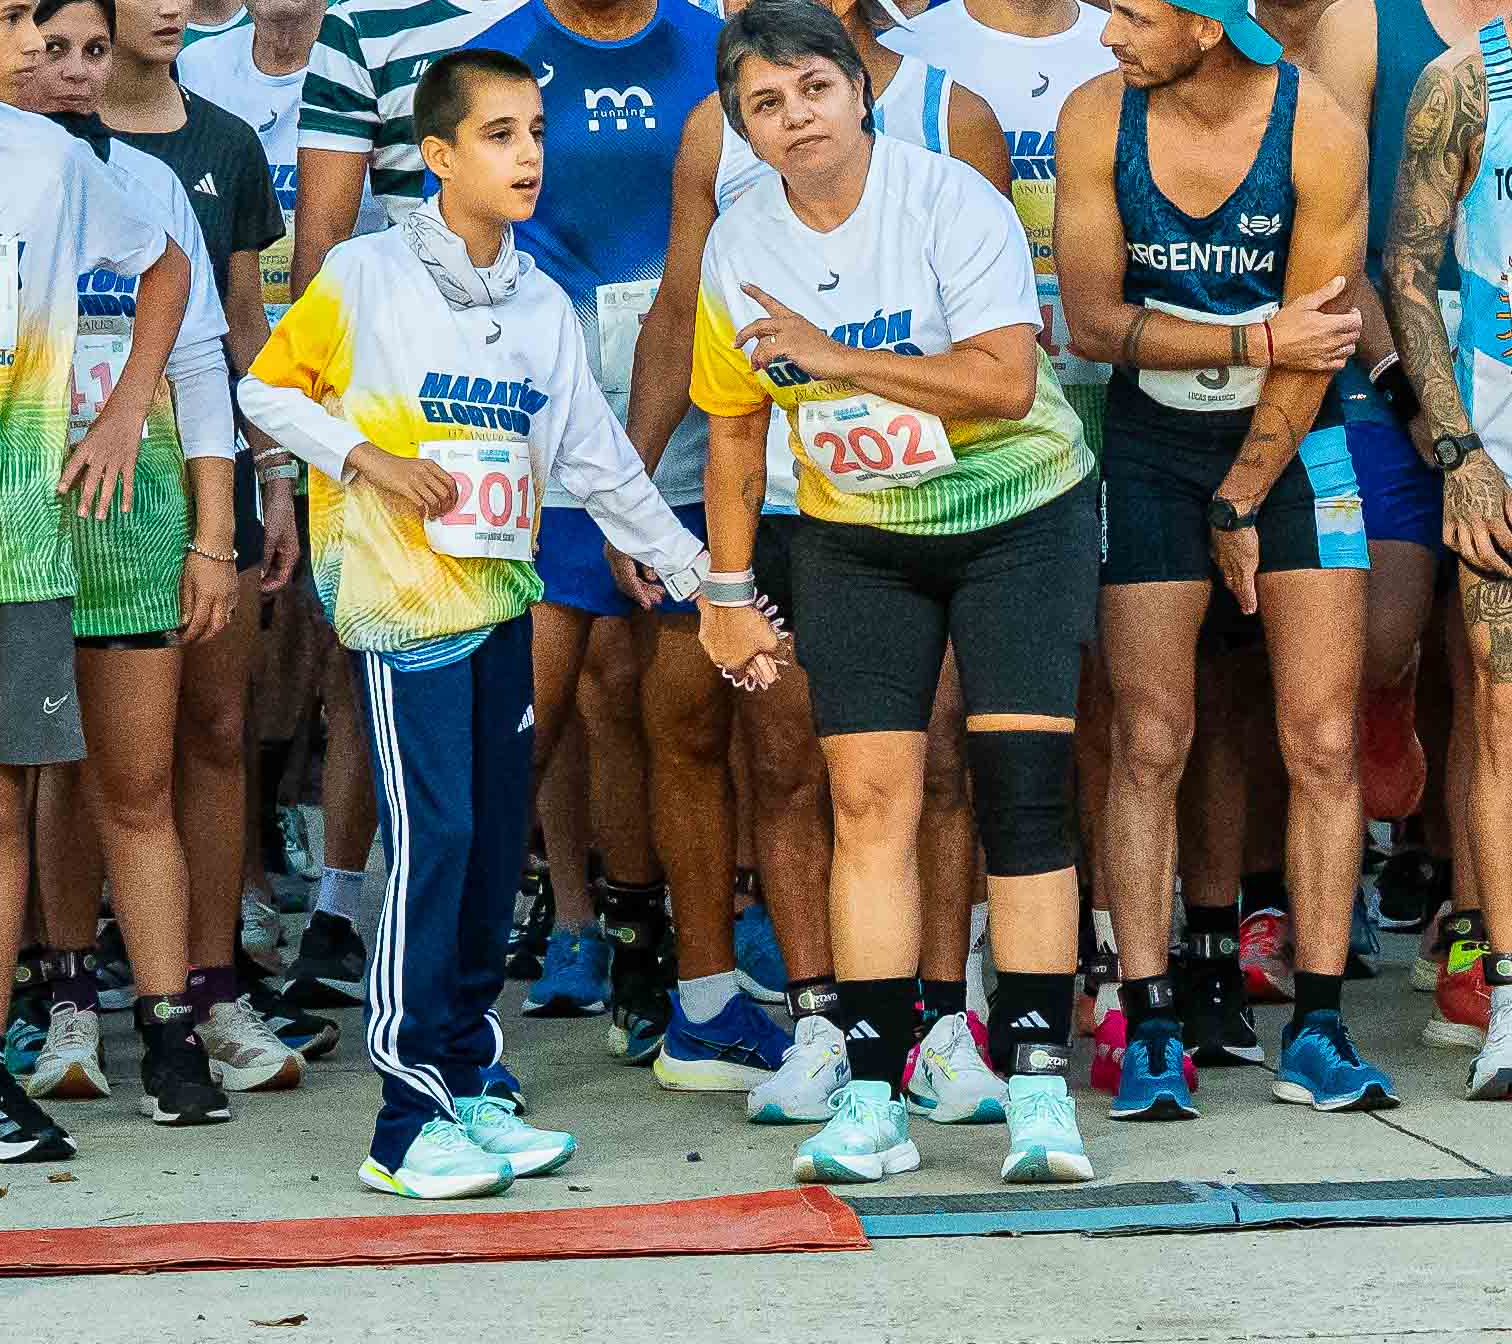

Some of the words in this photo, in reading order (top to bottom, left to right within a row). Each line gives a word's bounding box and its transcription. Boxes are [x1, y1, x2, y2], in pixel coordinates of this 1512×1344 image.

[593, 108, 646, 118] running
[829, 309, 913, 350] ATÓN
[814, 414, 937, 475] 202
[440, 471, 531, 529] 201
